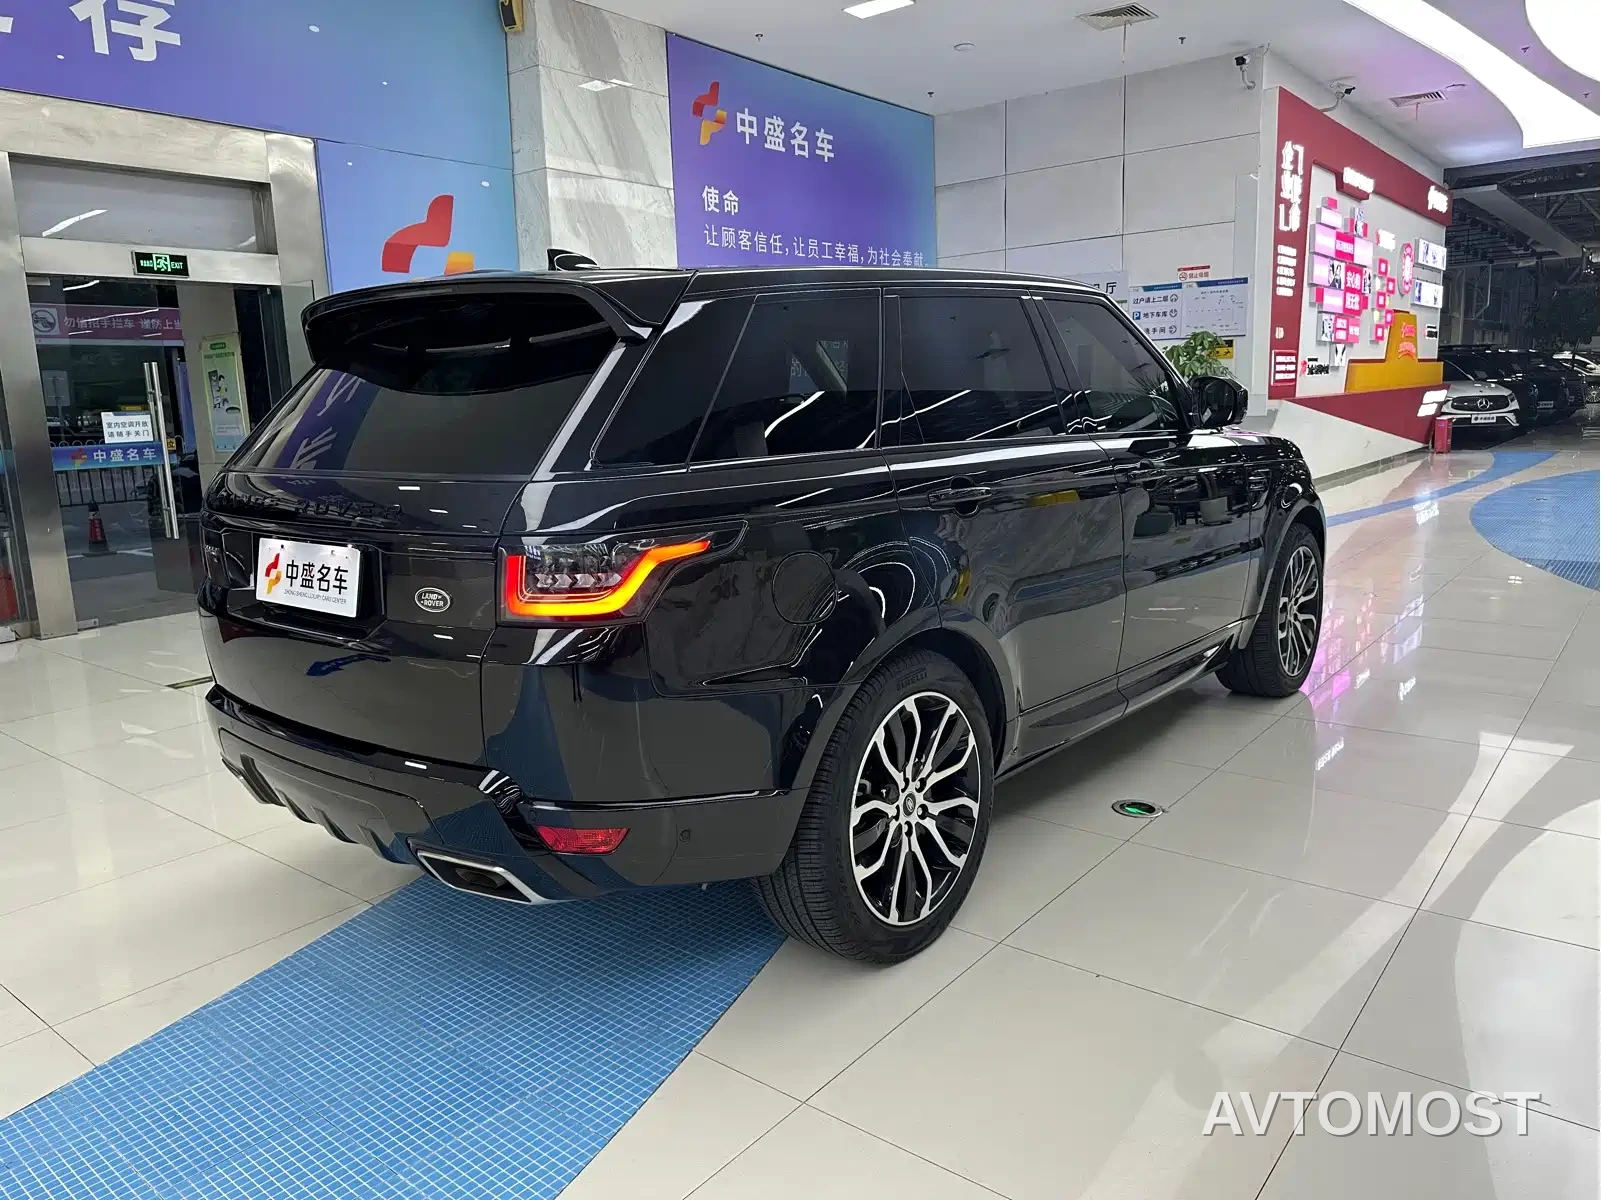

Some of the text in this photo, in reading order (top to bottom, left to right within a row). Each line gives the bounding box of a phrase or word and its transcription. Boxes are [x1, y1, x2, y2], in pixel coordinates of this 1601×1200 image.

[736, 107, 835, 163] 中盛名车
[702, 185, 740, 216] 使命
[171, 262, 184, 270] EXIT
[1132, 294, 1169, 304] 过户请上二层
[1143, 310, 1168, 319] 地下车库
[106, 420, 149, 429] 室内空调开放
[107, 429, 150, 438] 请随手关门
[93, 448, 157, 464] 中盛名车
[285, 559, 349, 595] 中盛名车
[421, 592, 439, 600] LAND
[423, 599, 444, 607] ROVER
